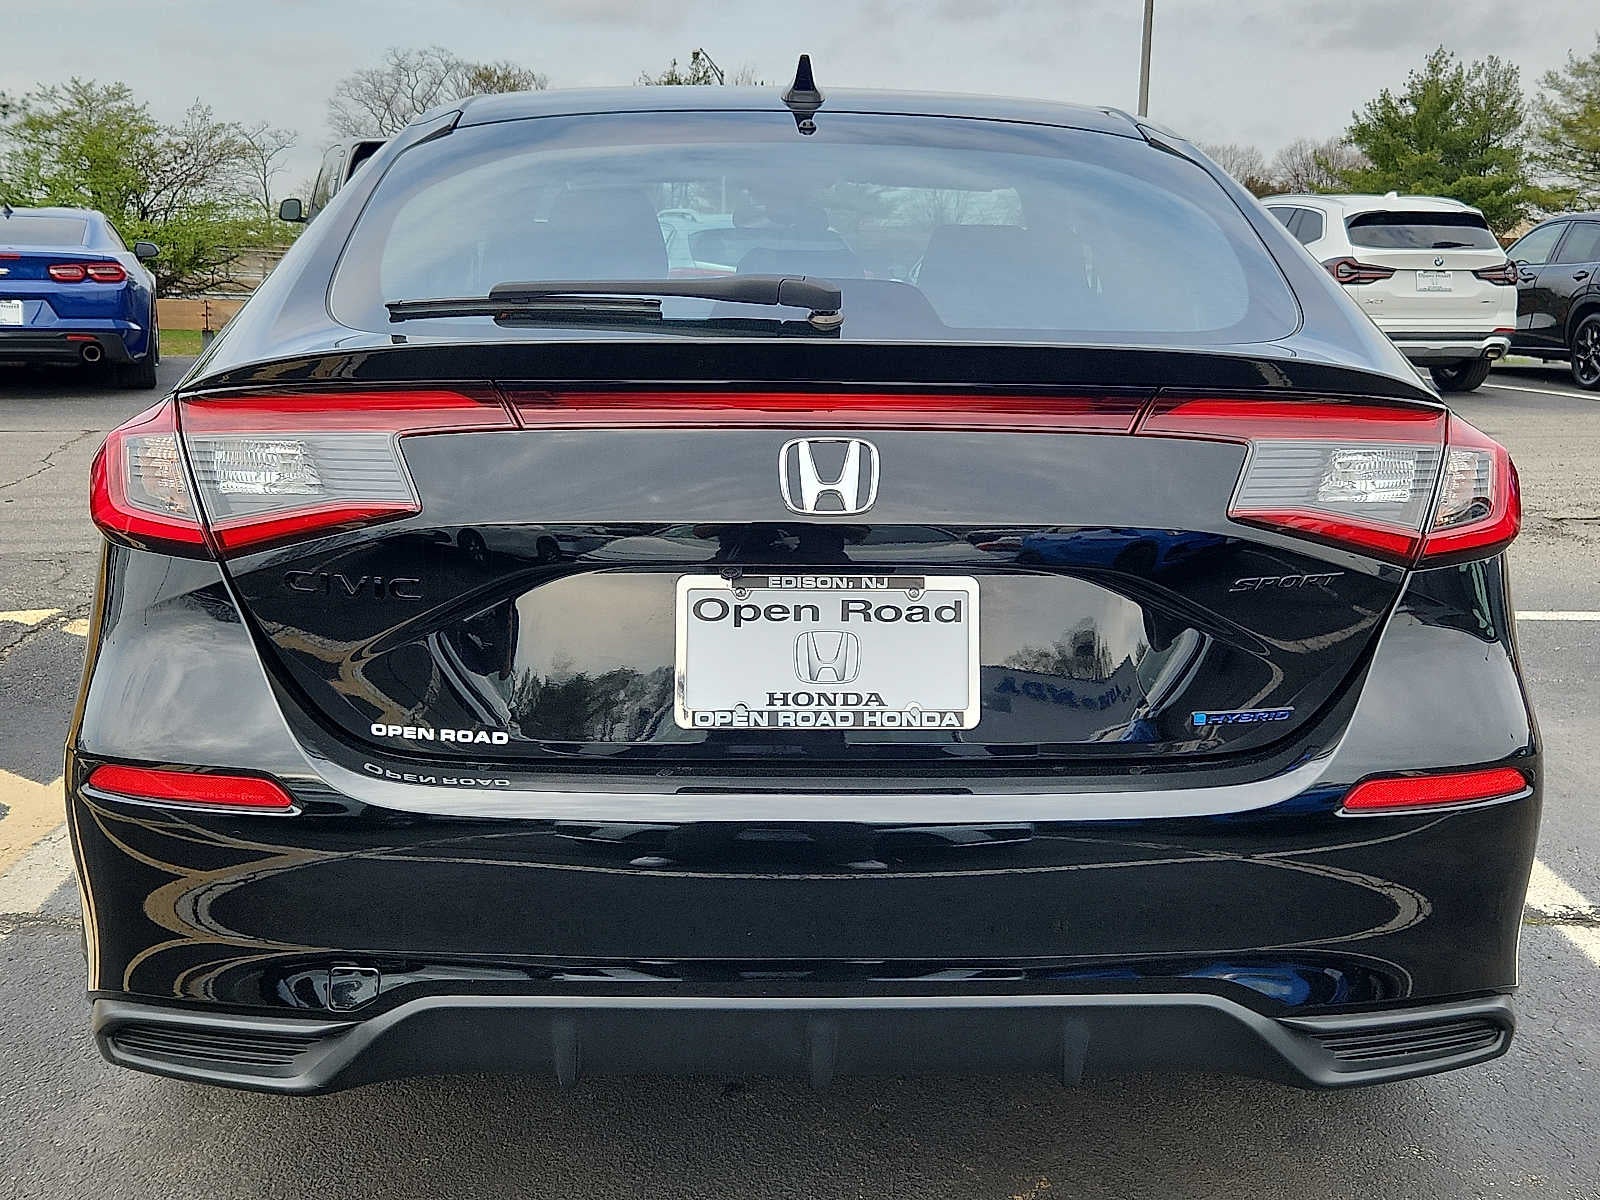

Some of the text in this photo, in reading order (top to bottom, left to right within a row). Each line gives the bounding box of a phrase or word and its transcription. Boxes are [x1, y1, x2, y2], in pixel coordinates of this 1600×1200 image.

[283, 570, 425, 600] CIVIC
[861, 576, 889, 589] NJ
[1228, 571, 1345, 593] SPORT
[692, 597, 962, 628] Open Road
[765, 691, 888, 708] HONDA
[694, 711, 961, 728] OPEN ROAD HONDA
[370, 723, 509, 746] OPEN ROAD
